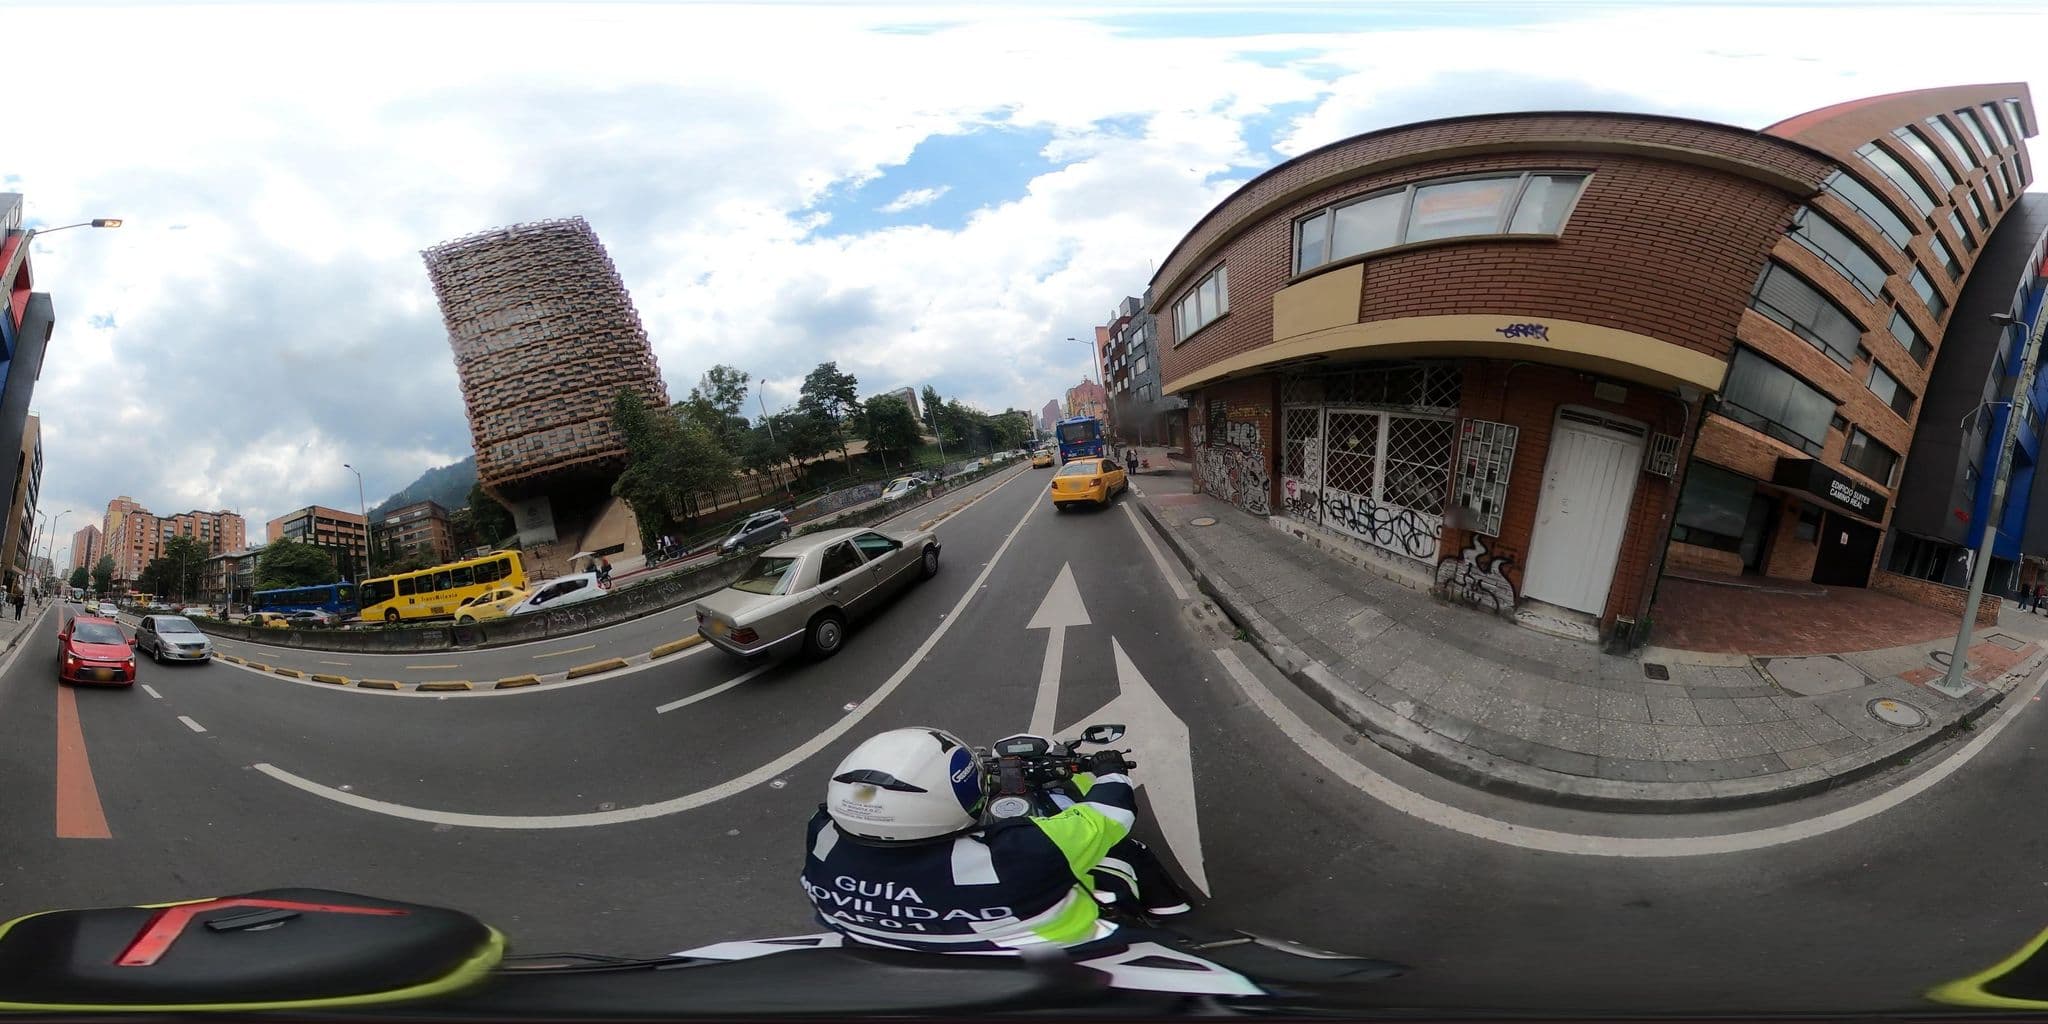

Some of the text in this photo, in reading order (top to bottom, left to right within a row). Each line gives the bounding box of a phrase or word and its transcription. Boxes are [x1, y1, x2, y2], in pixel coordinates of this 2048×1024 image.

[1830, 488, 1862, 509] CAMINO REAL
[1831, 480, 1870, 505] EDIFICIO SUITES
[800, 875, 1013, 921] MOVILIDAD
[835, 876, 923, 903] GUÍA
